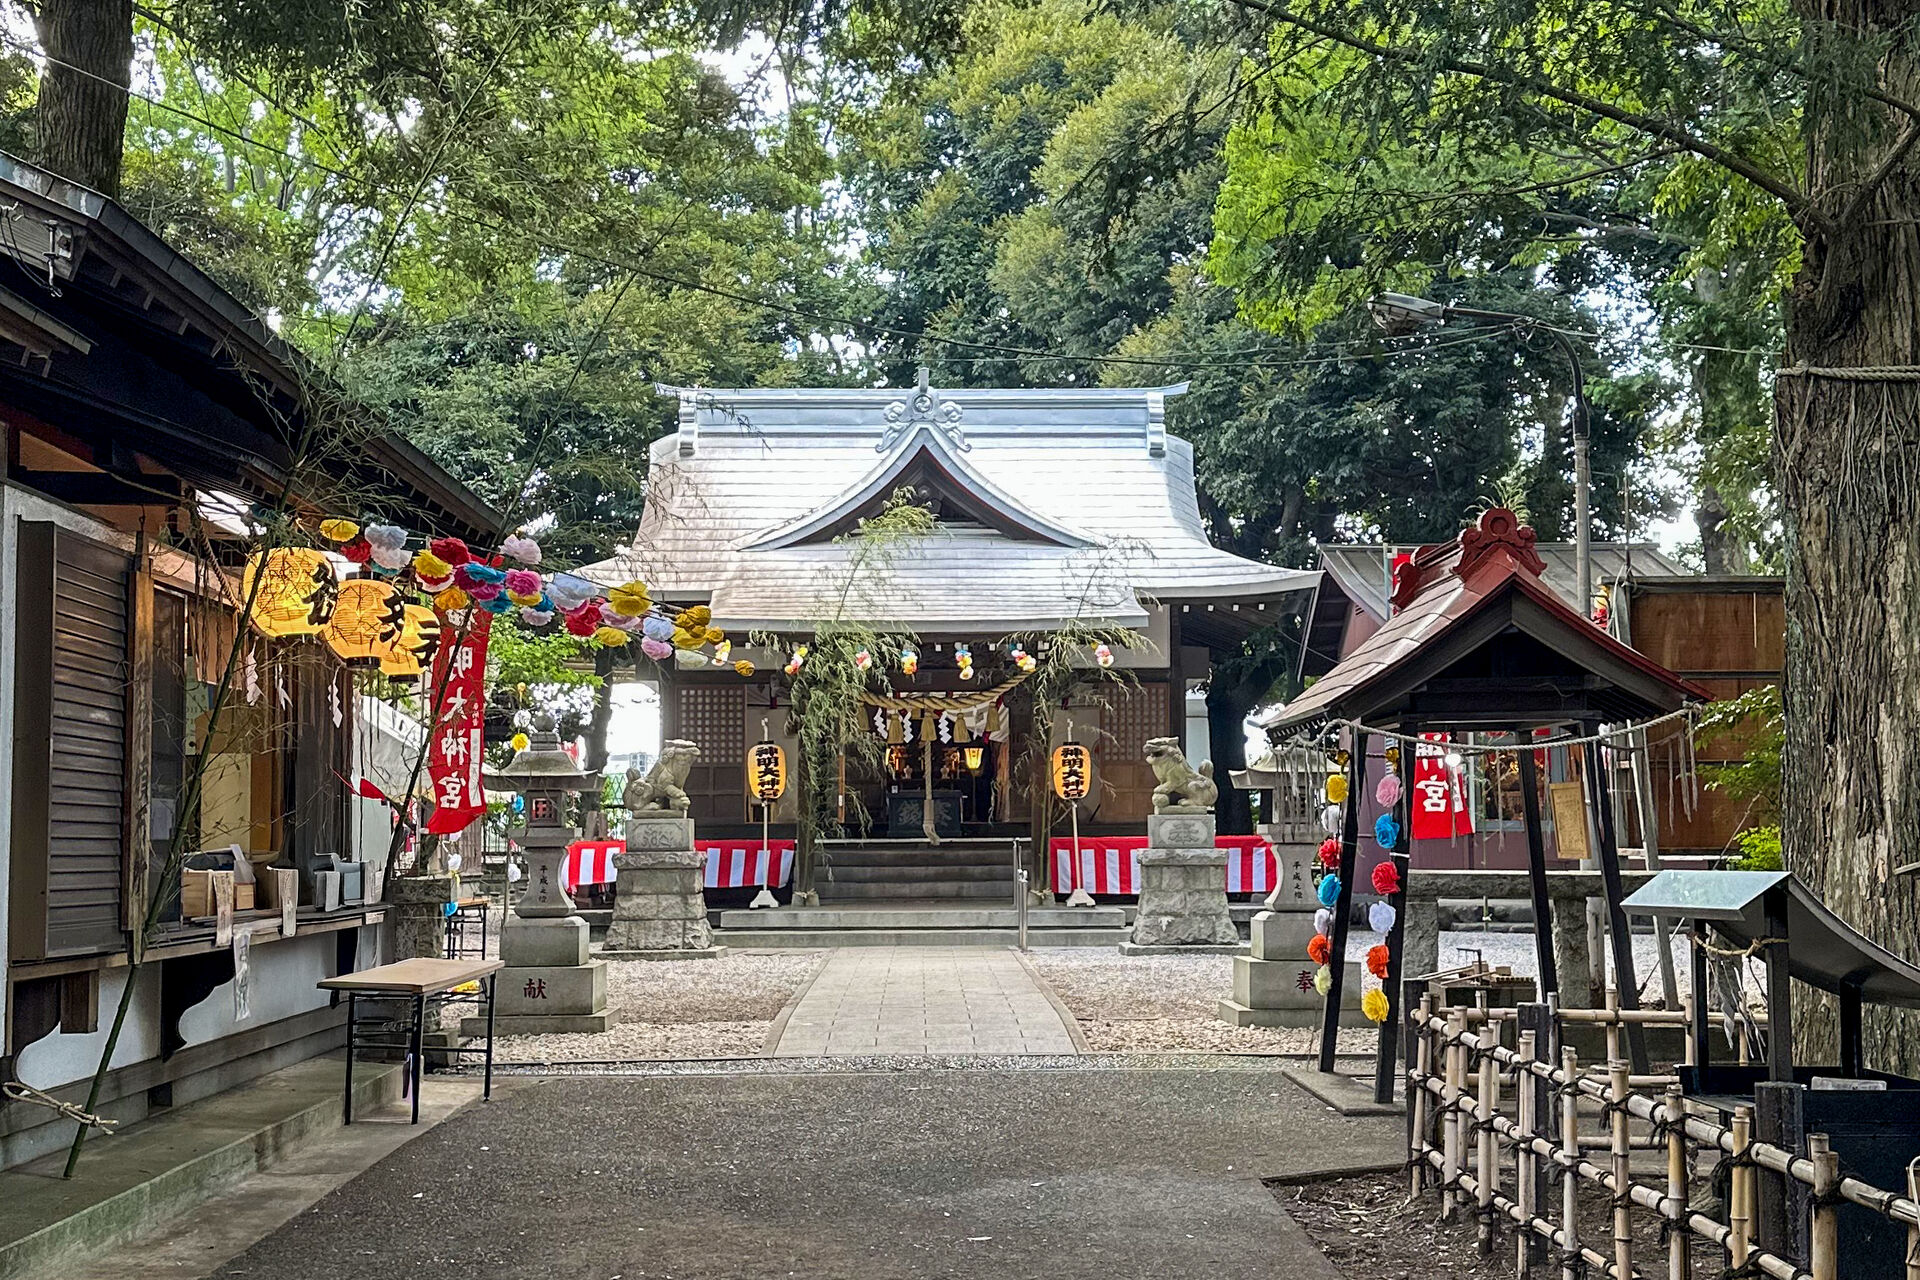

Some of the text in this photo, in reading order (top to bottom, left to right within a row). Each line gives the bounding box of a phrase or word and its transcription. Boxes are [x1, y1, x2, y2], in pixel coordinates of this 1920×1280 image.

[755, 746, 780, 797] 神明大神宮
[1060, 747, 1084, 798] 神明大神宮
[523, 977, 547, 999] 献
[1295, 970, 1315, 994] 奉
